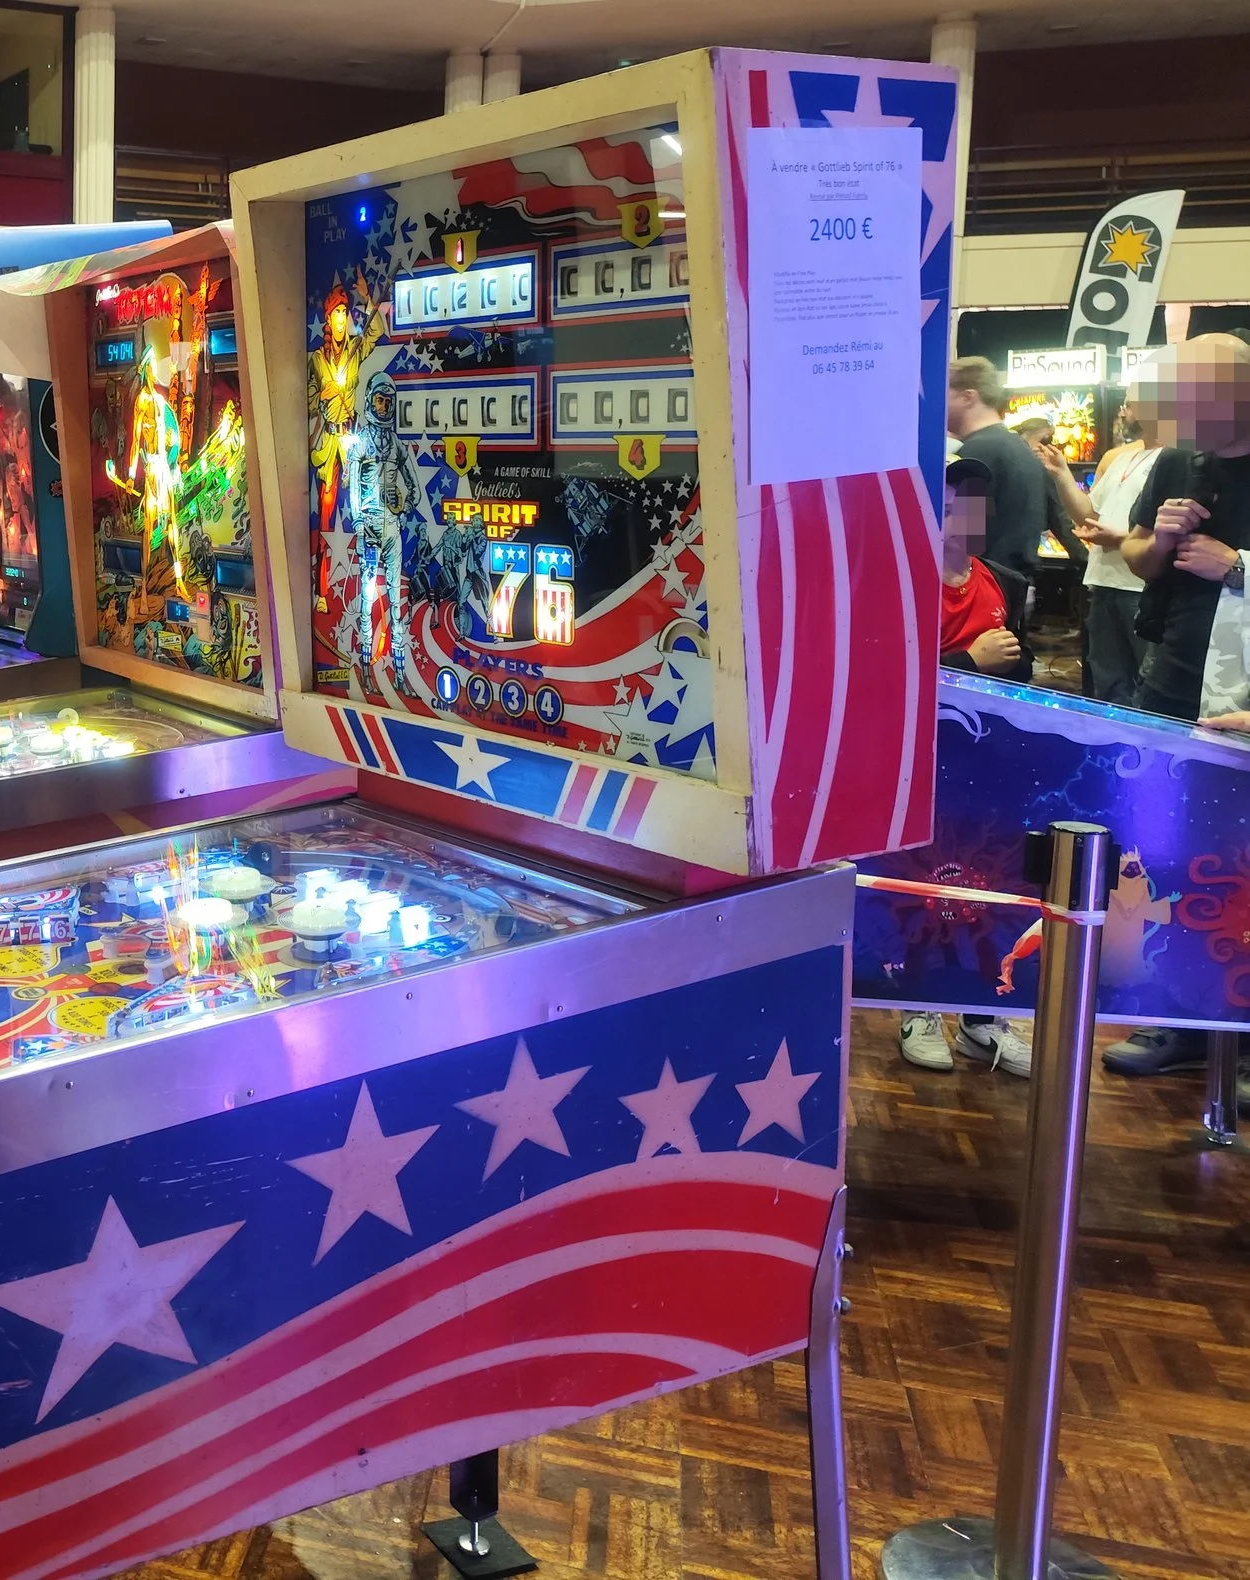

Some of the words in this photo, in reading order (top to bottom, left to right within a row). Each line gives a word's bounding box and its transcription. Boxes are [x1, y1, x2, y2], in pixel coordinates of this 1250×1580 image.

[779, 162, 808, 173] vendre
[817, 162, 851, 173] Gottlieb
[853, 161, 874, 175] Spirit
[875, 161, 885, 172] of
[885, 162, 895, 172] 76
[310, 203, 332, 218] BALL
[329, 215, 337, 229] IN
[635, 204, 650, 238] 2
[324, 228, 346, 243] PLAY
[810, 218, 856, 241] 2400
[862, 217, 873, 240] €
[114, 285, 174, 324] TOTEM
[803, 343, 848, 356] Demandez
[851, 340, 871, 353] Rémi
[873, 342, 883, 351] au
[812, 361, 824, 374] 06
[826, 361, 837, 373] 45
[839, 360, 850, 373] 78
[852, 360, 863, 372] 39
[865, 359, 874, 371] 64
[1012, 351, 1096, 374] PinSound
[455, 441, 467, 470] 3
[628, 439, 647, 470] 4
[494, 468, 499, 478] A
[500, 468, 520, 478] GAME
[521, 468, 530, 478] OF
[530, 468, 551, 478] SKILL
[474, 480, 521, 501] Gottlieb's
[443, 502, 538, 525] SPIRIT
[487, 525, 514, 539] OF
[486, 541, 575, 647] 76
[452, 647, 544, 680] PLAYERS
[443, 673, 451, 699] 1
[474, 680, 486, 705] 2
[507, 685, 519, 711] 3
[541, 692, 554, 717] 4
[431, 698, 450, 712] CAN
[542, 725, 568, 738] TIME
[55, 920, 67, 939] 6
